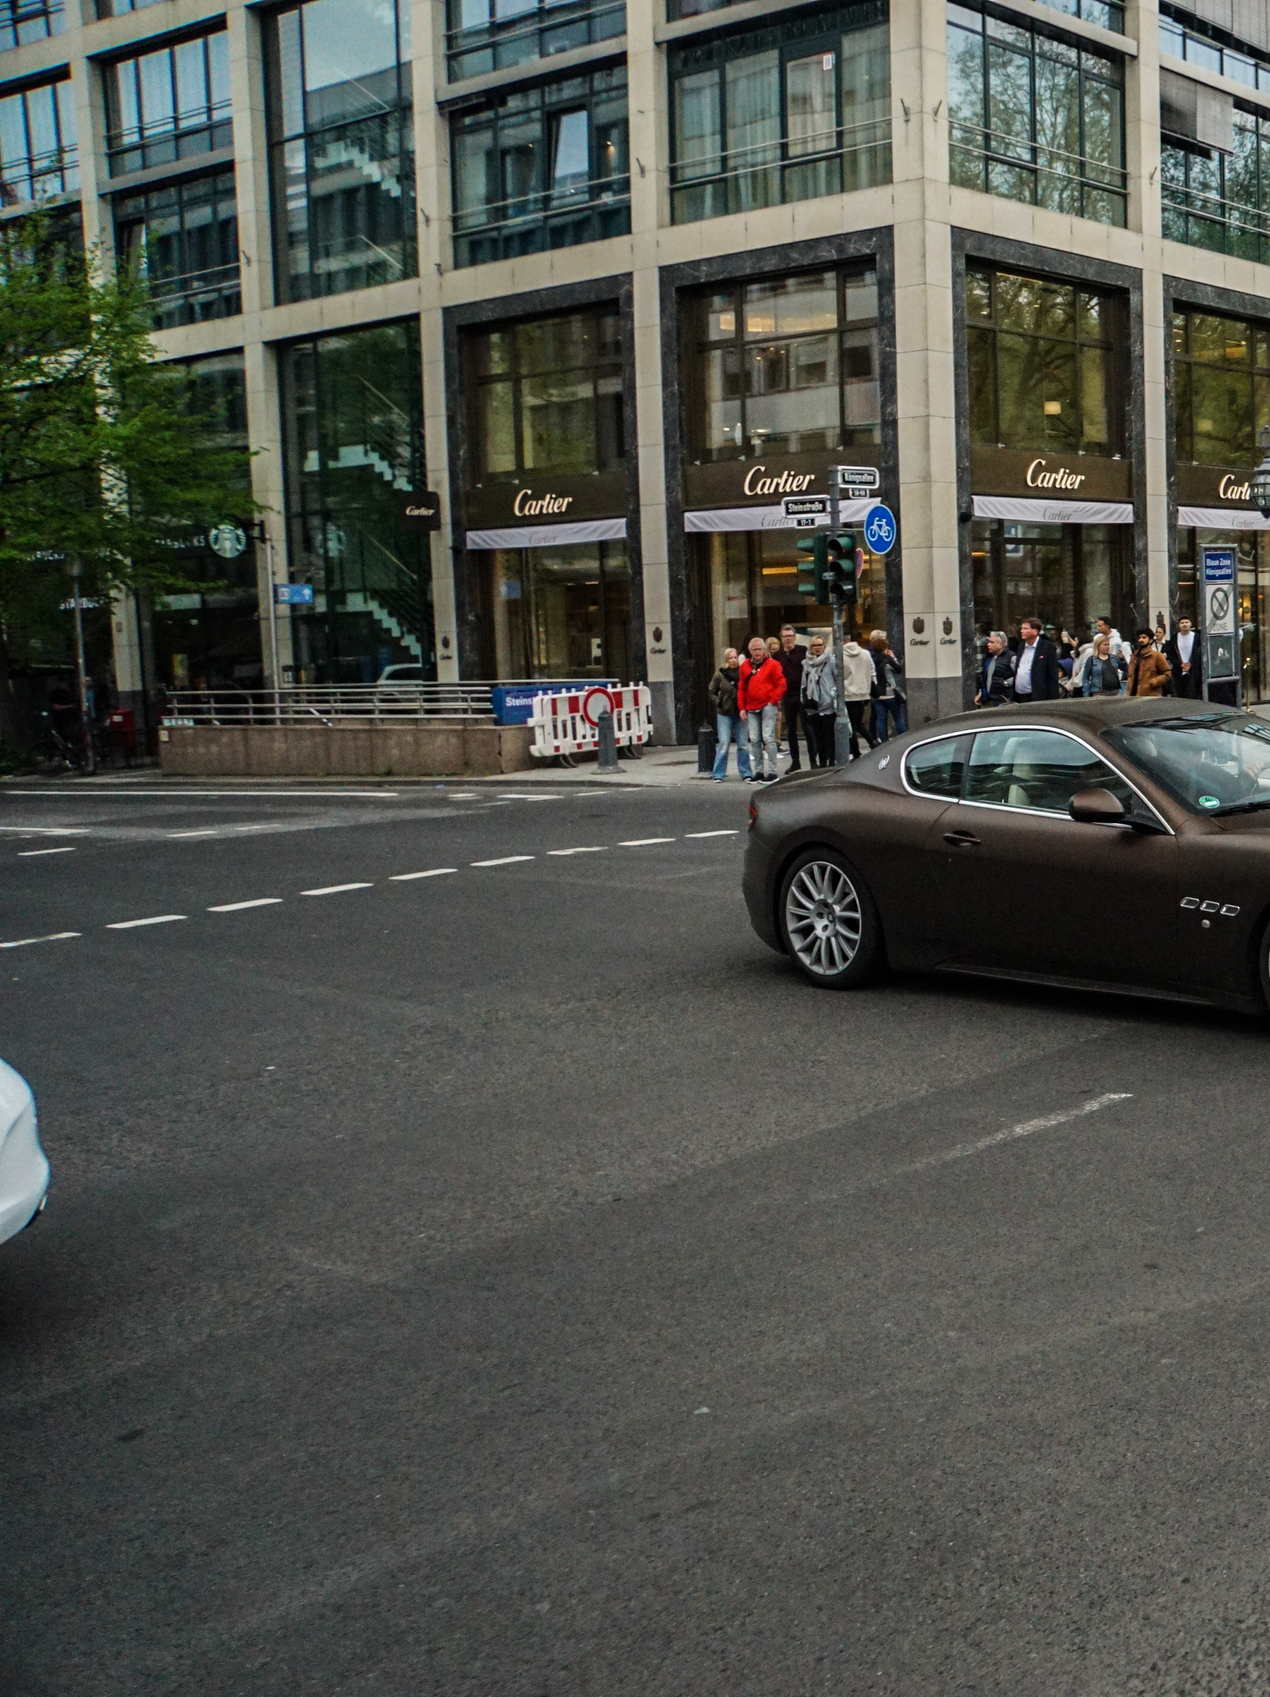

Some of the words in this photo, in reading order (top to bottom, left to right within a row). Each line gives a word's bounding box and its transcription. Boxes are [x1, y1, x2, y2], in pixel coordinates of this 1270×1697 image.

[1026, 458, 1086, 490] Cartier
[743, 465, 816, 496] Cartier
[513, 488, 573, 517] Cartier
[788, 502, 823, 513] Steinstraße
[405, 505, 436, 517] Cartier
[1043, 506, 1073, 521] Cartier
[1220, 558, 1231, 566] Zone
[1213, 622, 1228, 631] ZONE
[910, 638, 930, 646] Cartier
[940, 637, 957, 645] Cartier
